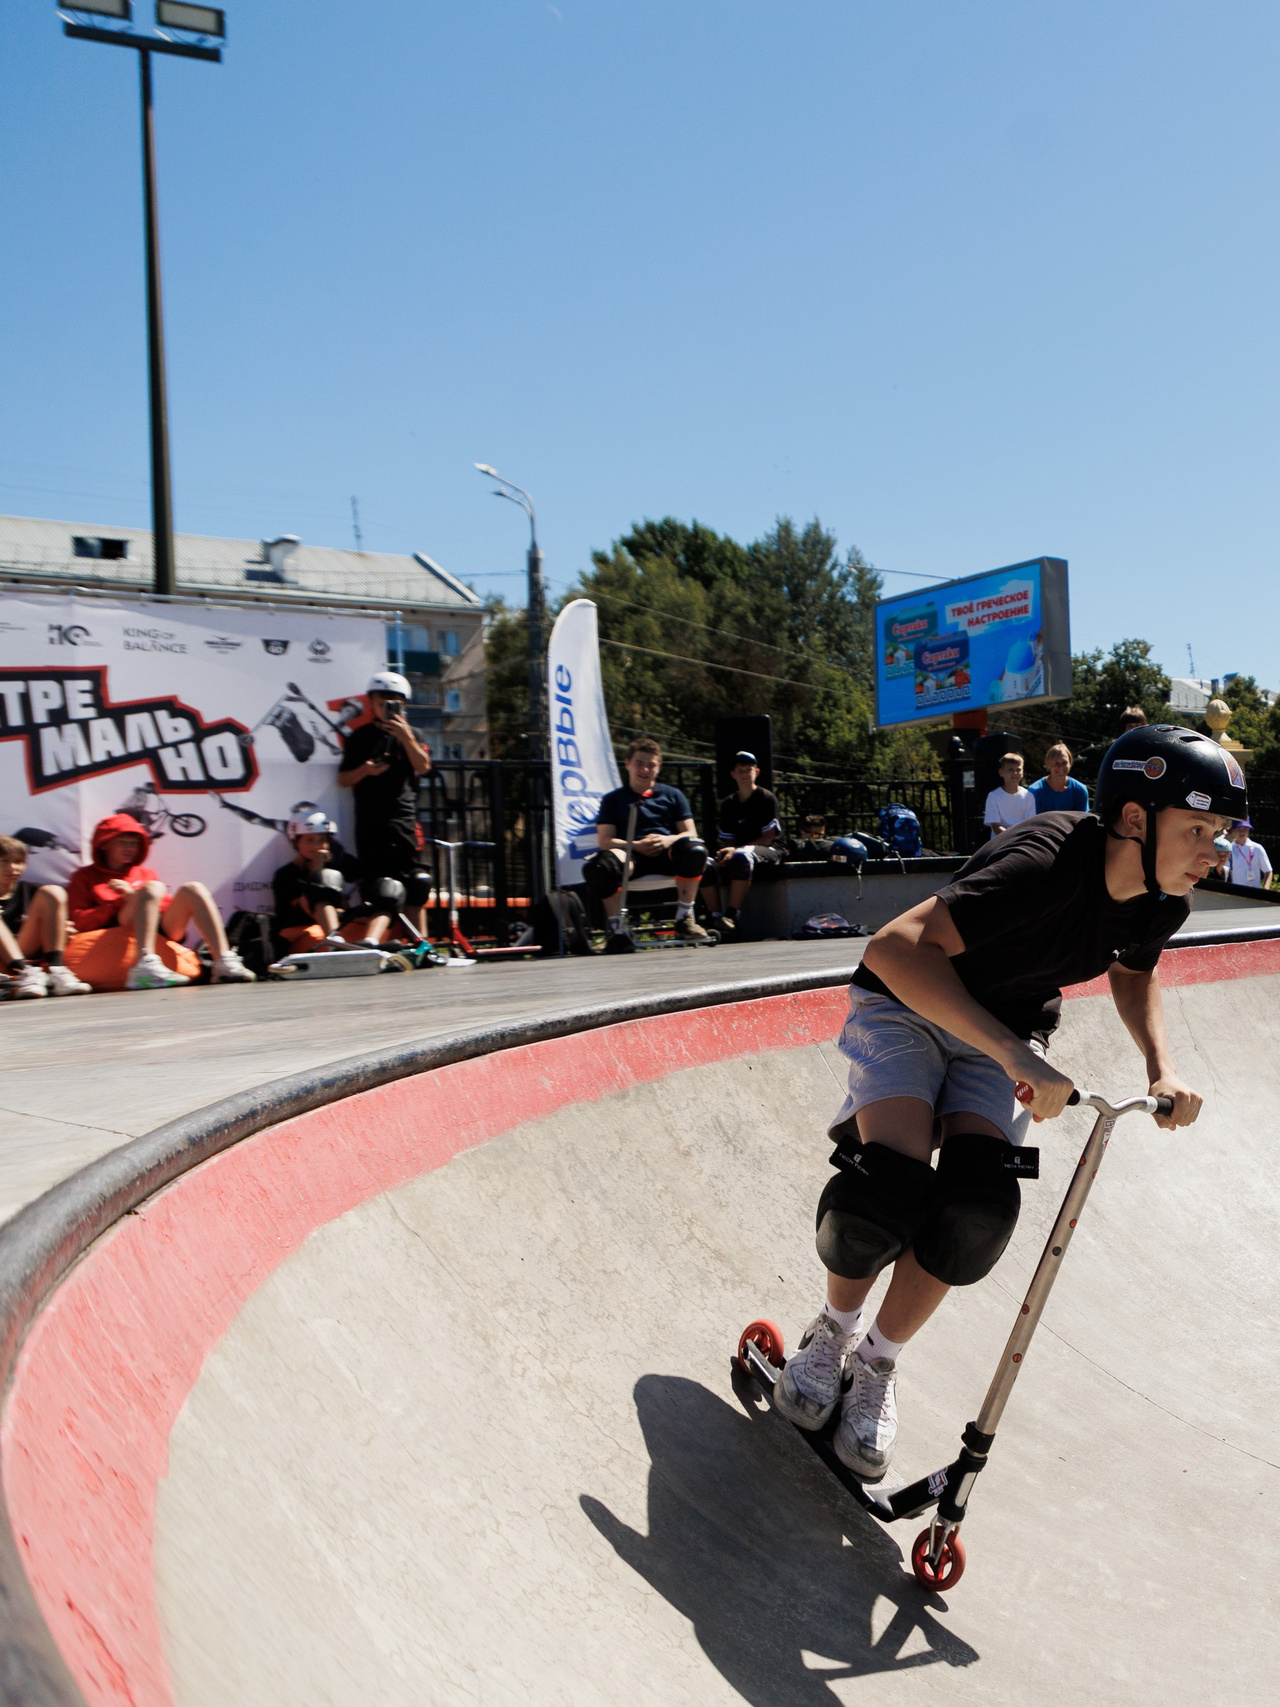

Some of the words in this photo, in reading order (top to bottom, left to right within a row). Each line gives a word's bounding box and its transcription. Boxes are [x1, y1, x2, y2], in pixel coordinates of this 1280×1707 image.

[951, 602, 975, 617] ТВОЁ
[976, 590, 1029, 612] ГРЕЧЕСКОЕ
[967, 604, 1029, 627] НАСТРОЕНИЕ
[123, 626, 160, 639] KING
[39, 709, 195, 776] МАЛЬ
[157, 731, 246, 781] НО
